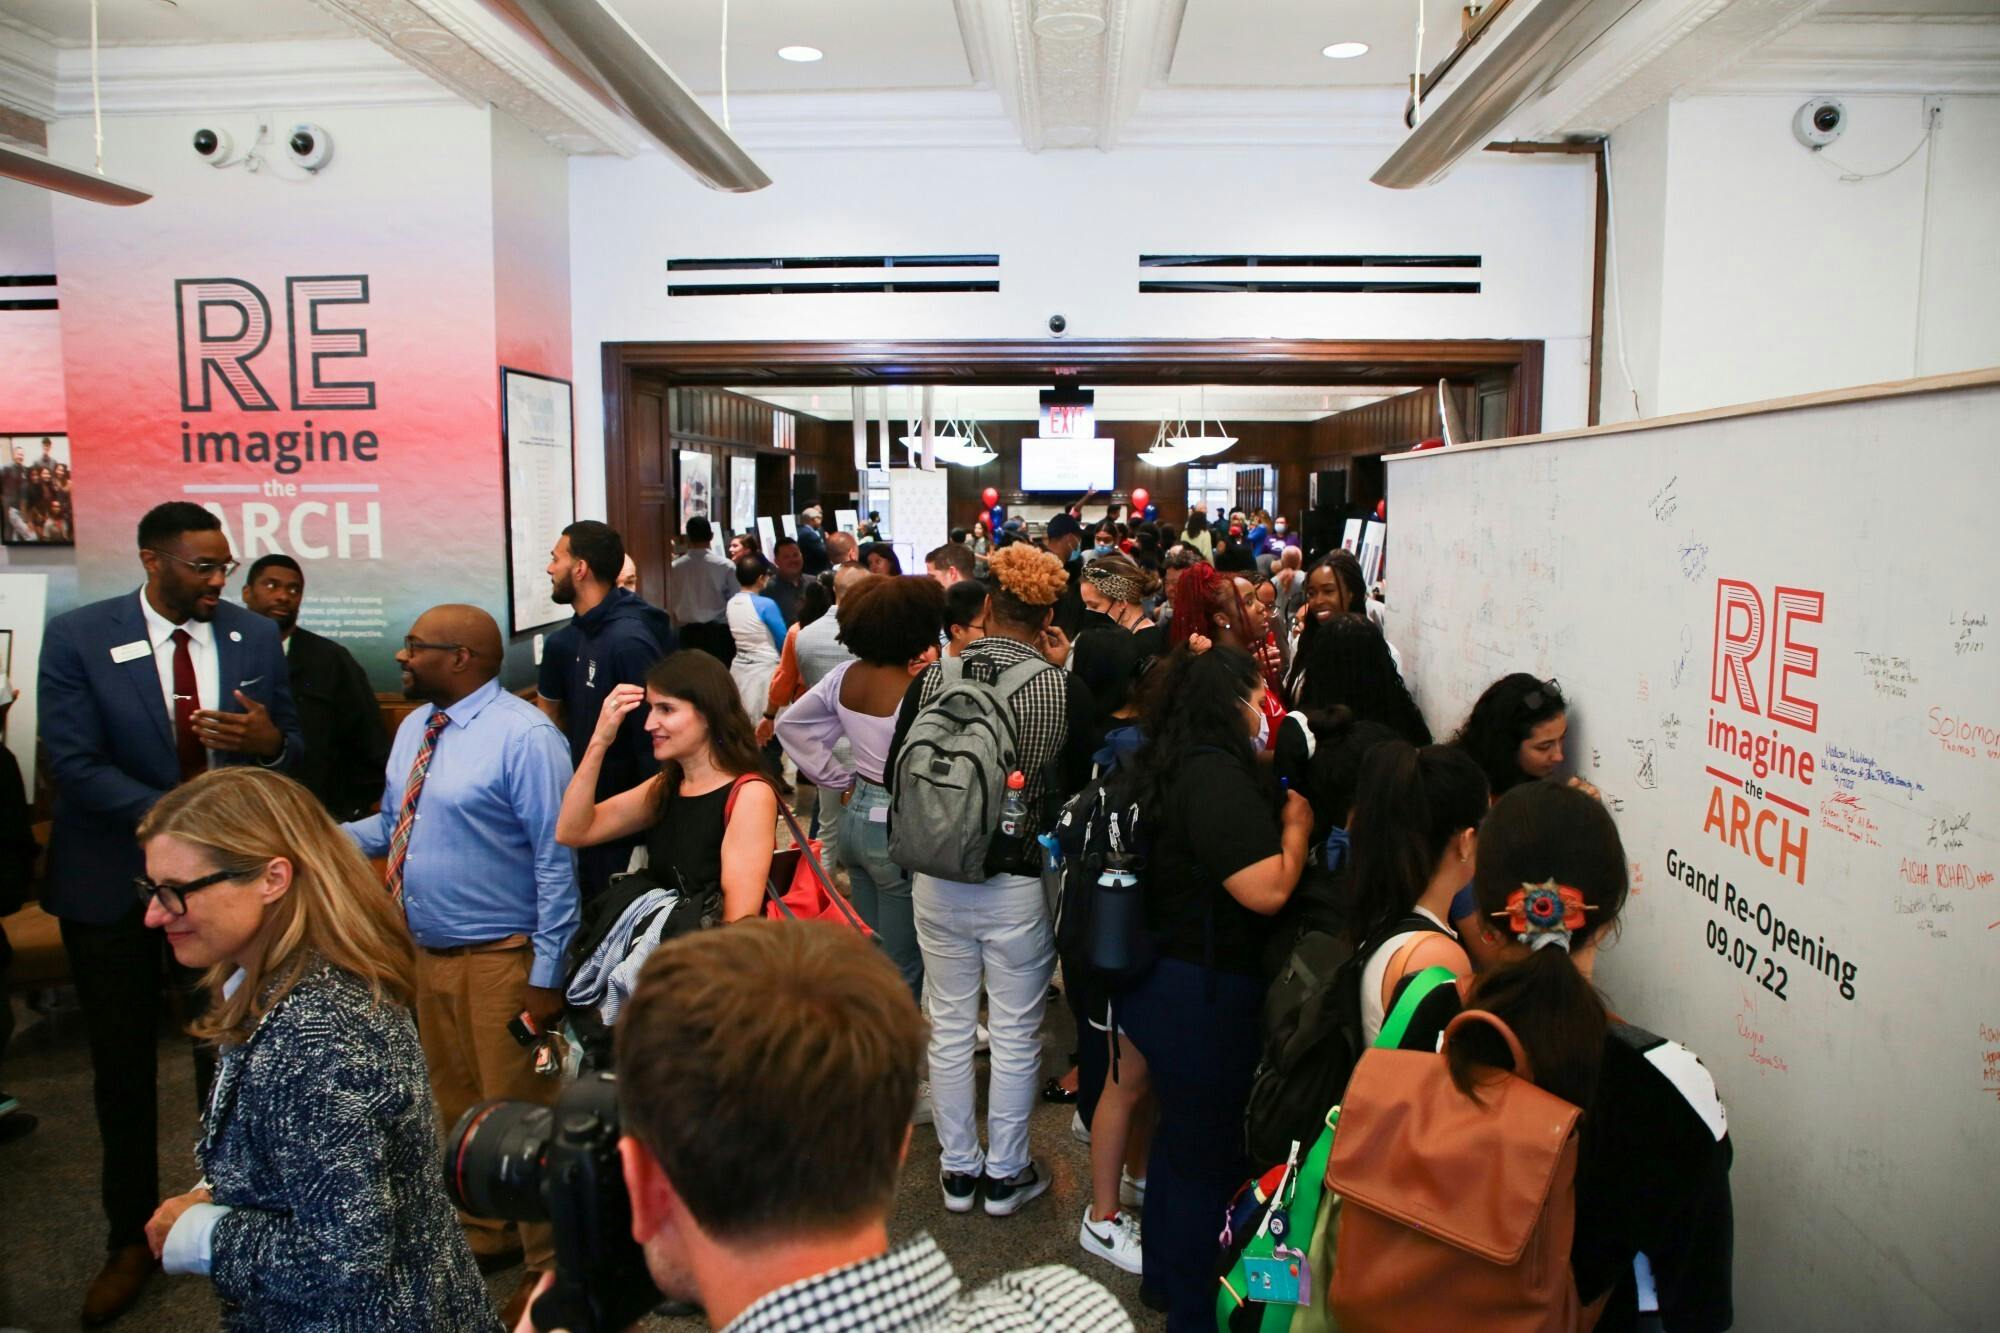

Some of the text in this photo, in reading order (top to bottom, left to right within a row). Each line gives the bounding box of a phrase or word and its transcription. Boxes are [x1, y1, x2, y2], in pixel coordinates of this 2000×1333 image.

[174, 274, 377, 412] RE
[181, 420, 379, 475] imagine
[1049, 406, 1086, 434] EXIT
[263, 478, 297, 498] the
[1710, 576, 1825, 733] RE
[1708, 708, 1815, 786] imagine
[1745, 778, 1763, 800] the
[1703, 785, 1810, 885] ARCH
[1666, 848, 1858, 1001] Grand Re-Opening
[1706, 919, 1788, 1001] 09.07.22
